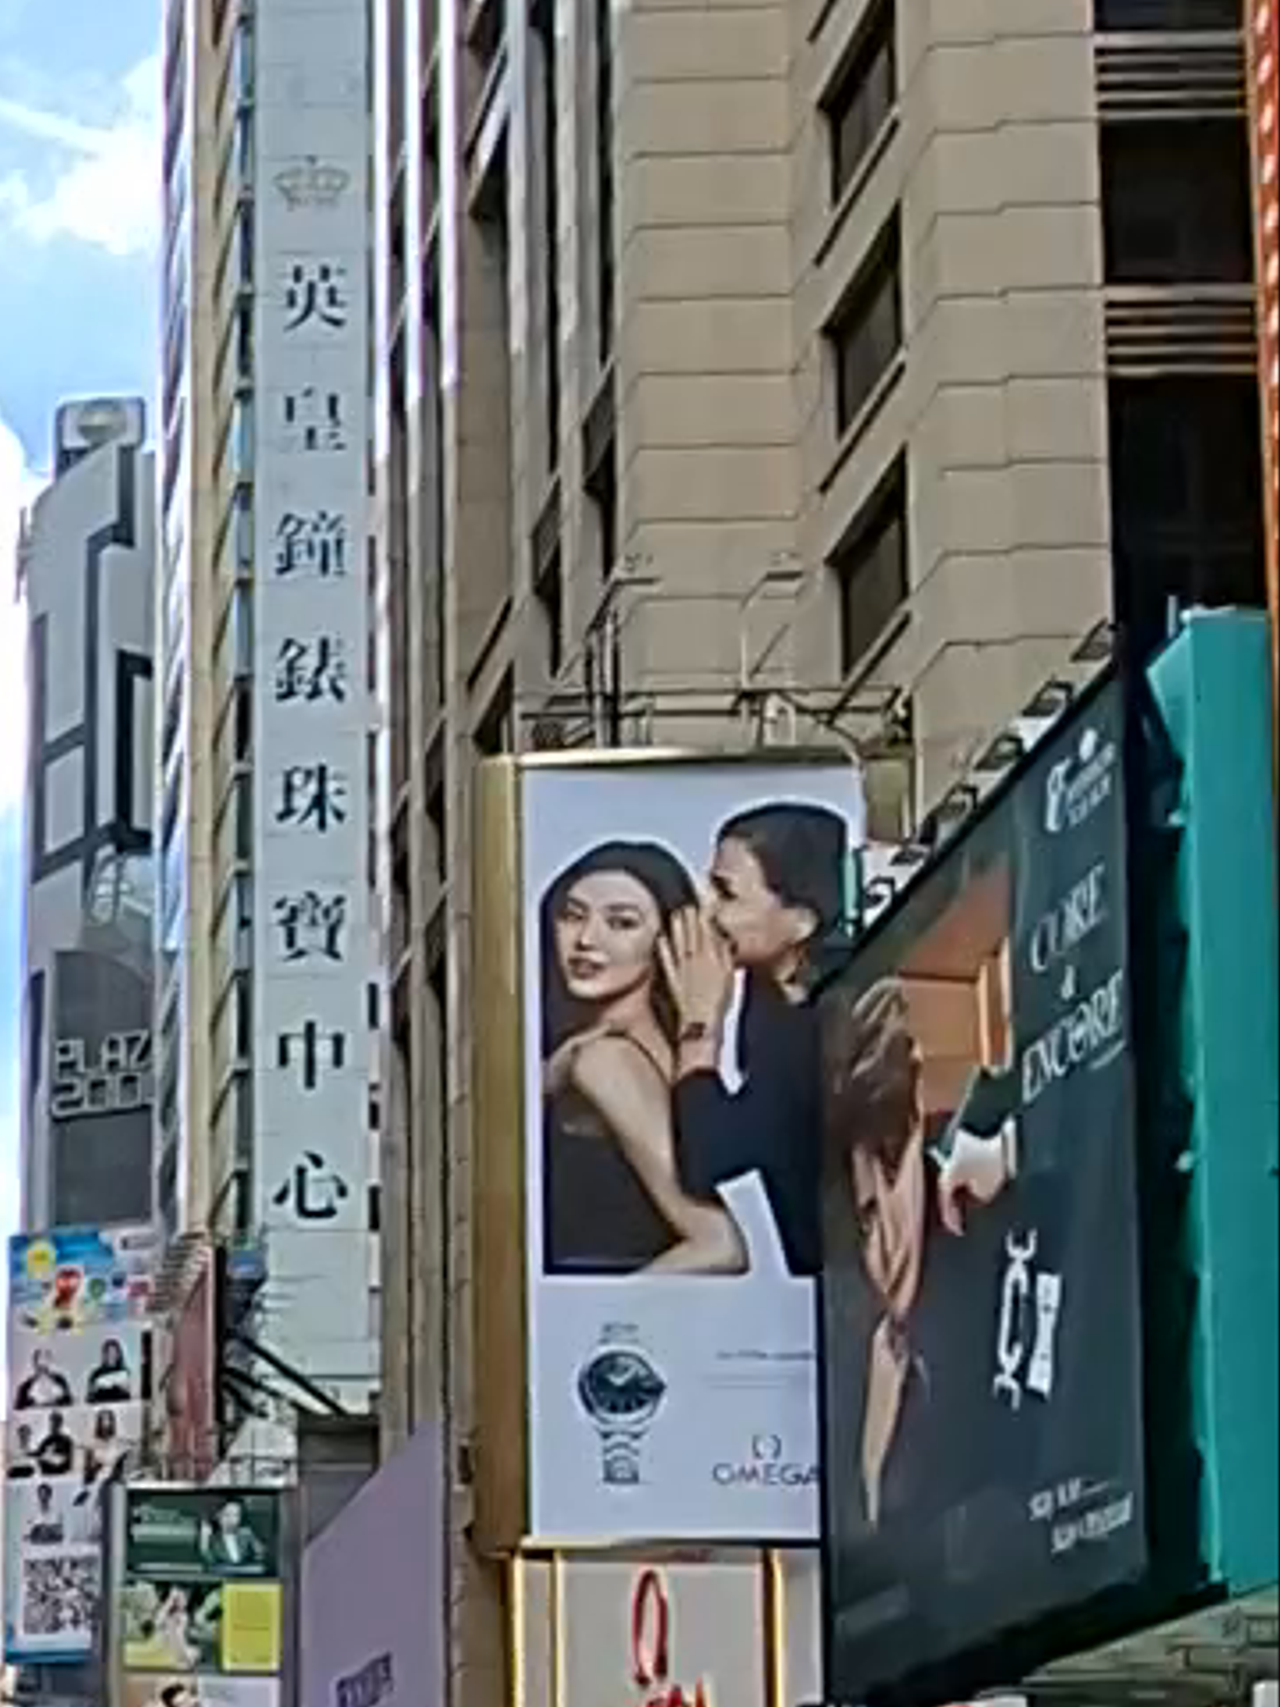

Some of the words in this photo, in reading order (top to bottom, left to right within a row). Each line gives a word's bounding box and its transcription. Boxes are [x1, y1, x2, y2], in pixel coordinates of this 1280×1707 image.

[54, 1028, 154, 1079] PLAZ
[50, 1070, 156, 1117] 200
[711, 1461, 819, 1487] OMEGA
